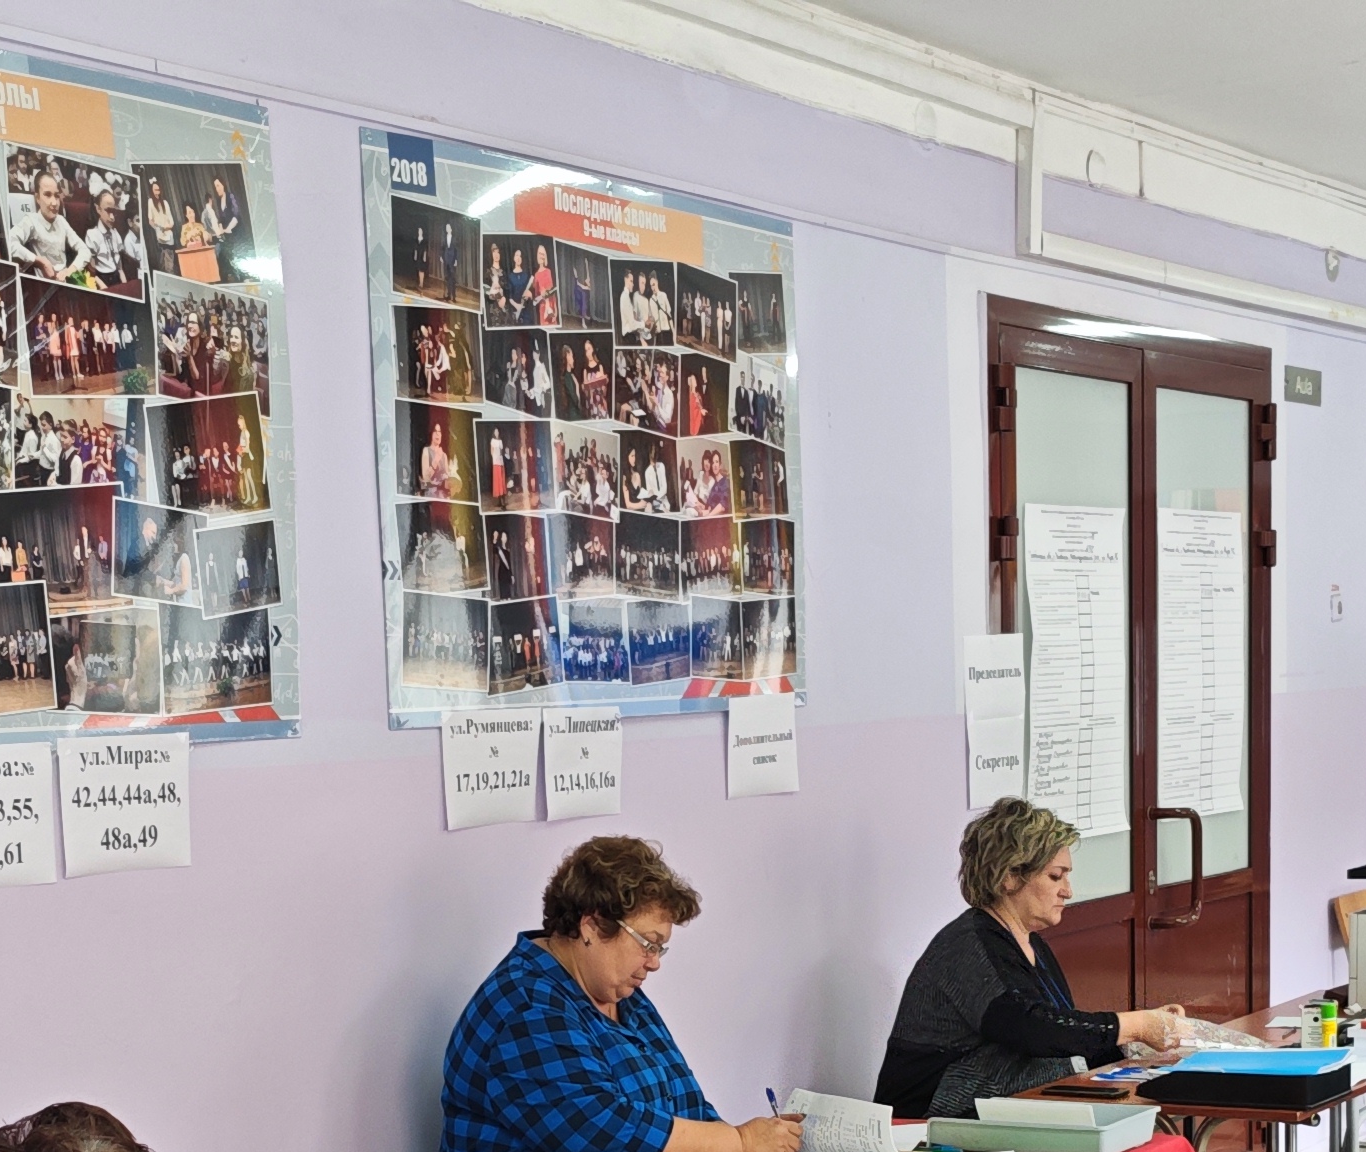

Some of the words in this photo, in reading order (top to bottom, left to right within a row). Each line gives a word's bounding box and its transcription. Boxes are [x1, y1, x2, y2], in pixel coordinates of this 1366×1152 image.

[390, 158, 428, 187] 2018
[554, 187, 622, 225] Последний
[623, 207, 667, 233] звонок
[583, 219, 605, 240] 9-ые
[605, 227, 640, 246] классы
[968, 667, 1022, 683] Председатель
[450, 718, 533, 738] ул.Румянцева:
[975, 755, 1020, 772] Секретарь
[456, 769, 530, 795] 17,19,21,21а
[553, 771, 616, 795] 12,14,16,16а
[71, 782, 182, 812] 42,44,44а,48,
[100, 825, 158, 853] 48а,49
